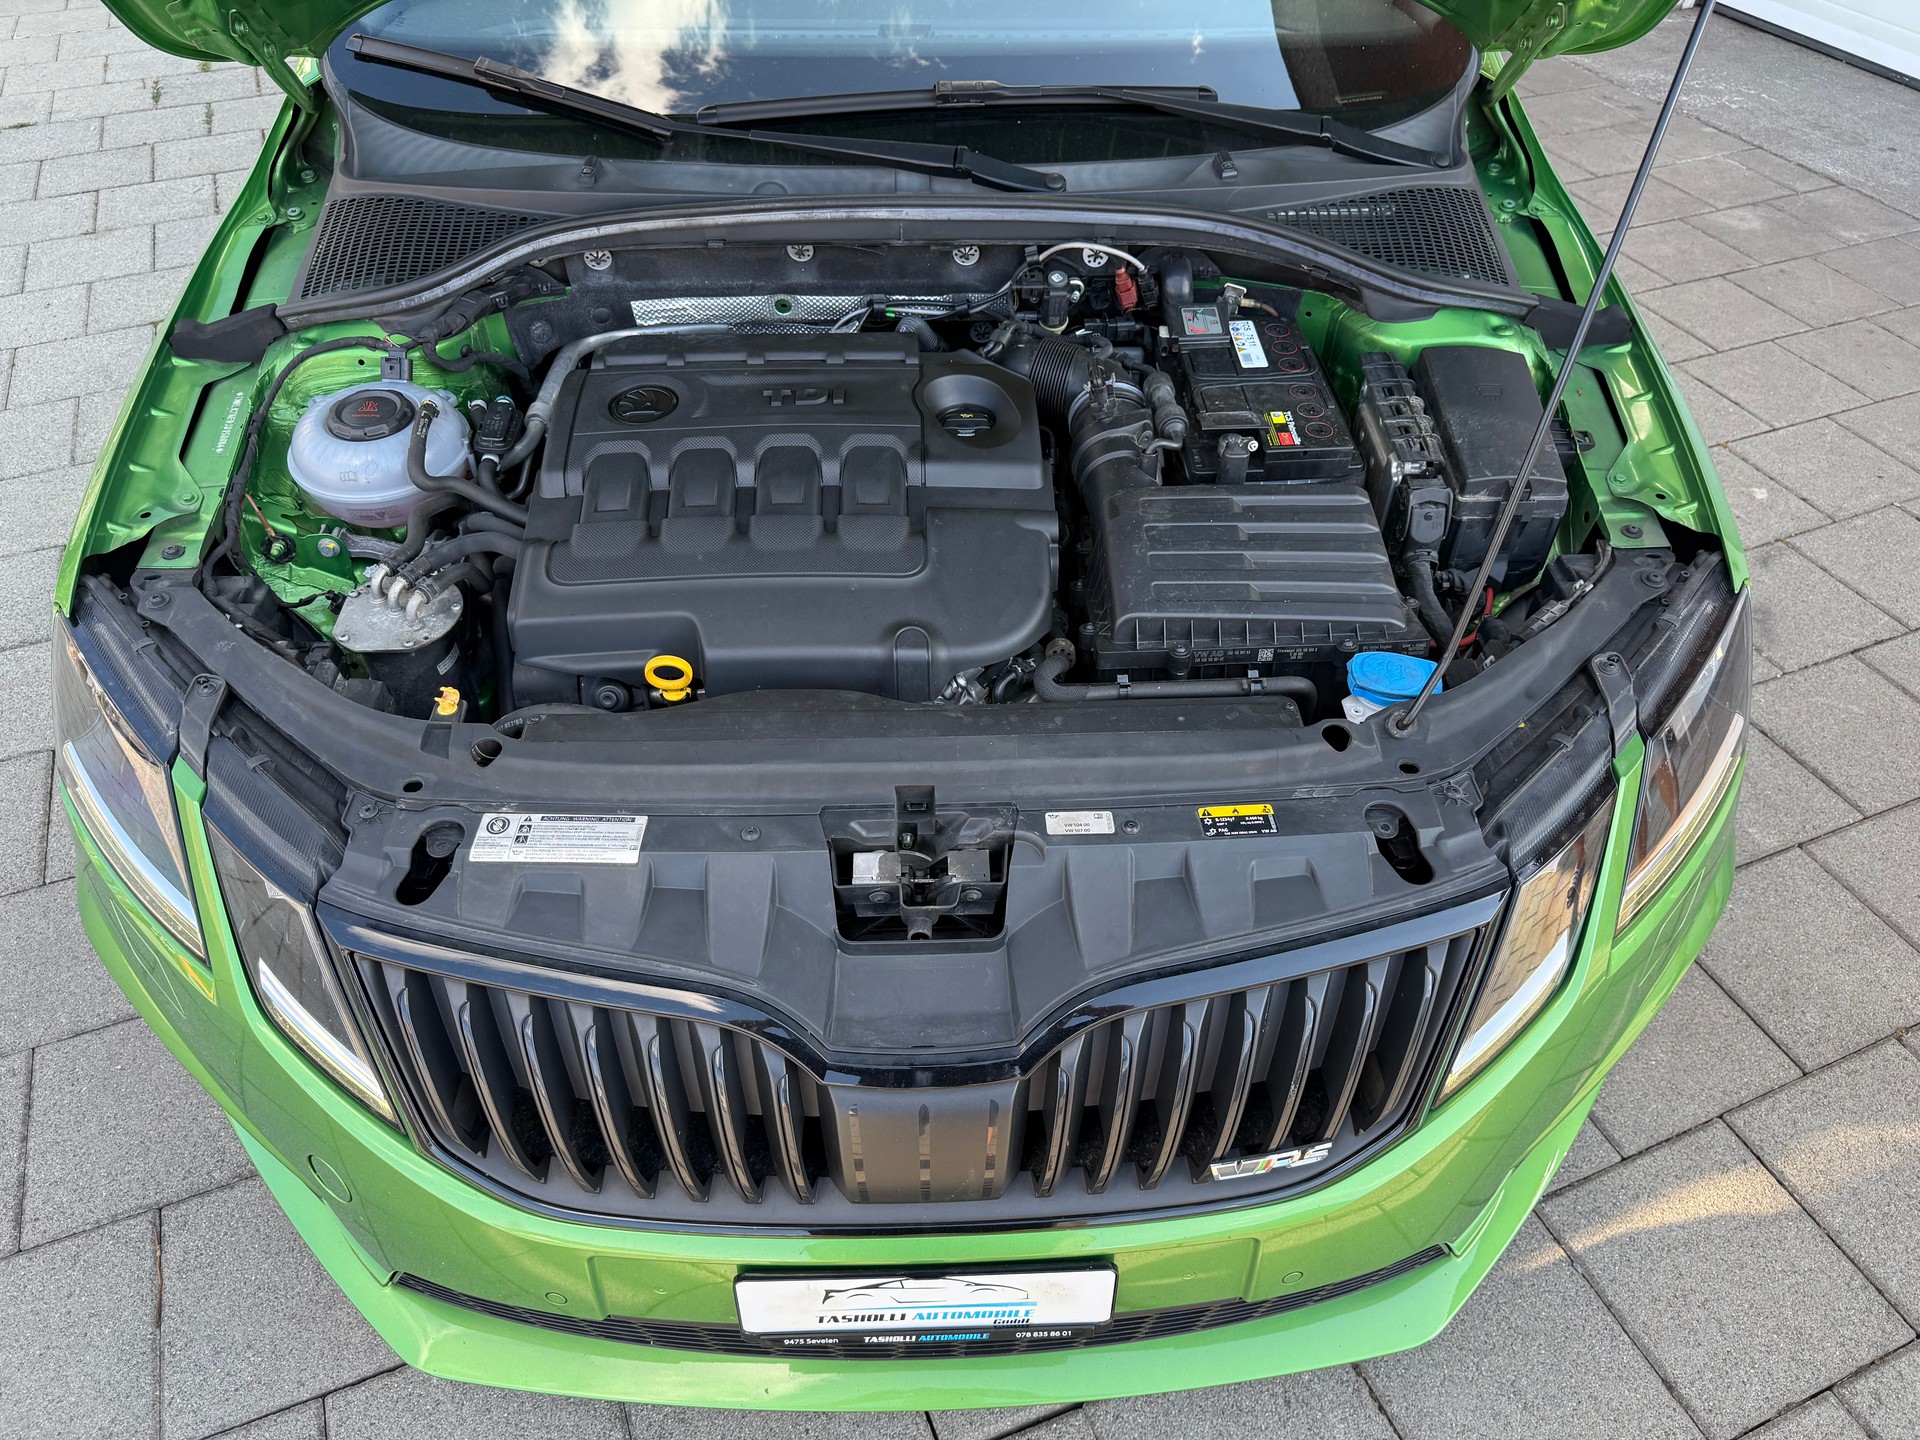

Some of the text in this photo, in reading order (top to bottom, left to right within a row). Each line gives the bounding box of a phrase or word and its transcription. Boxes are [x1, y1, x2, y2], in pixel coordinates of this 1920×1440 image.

[762, 389, 845, 407] TDI
[1283, 411, 1294, 422] TCS
[816, 1308, 1036, 1324] TASHOLLI AUTOMOBILE
[863, 1332, 991, 1343] TASHOLLI AUTOMOBILE
